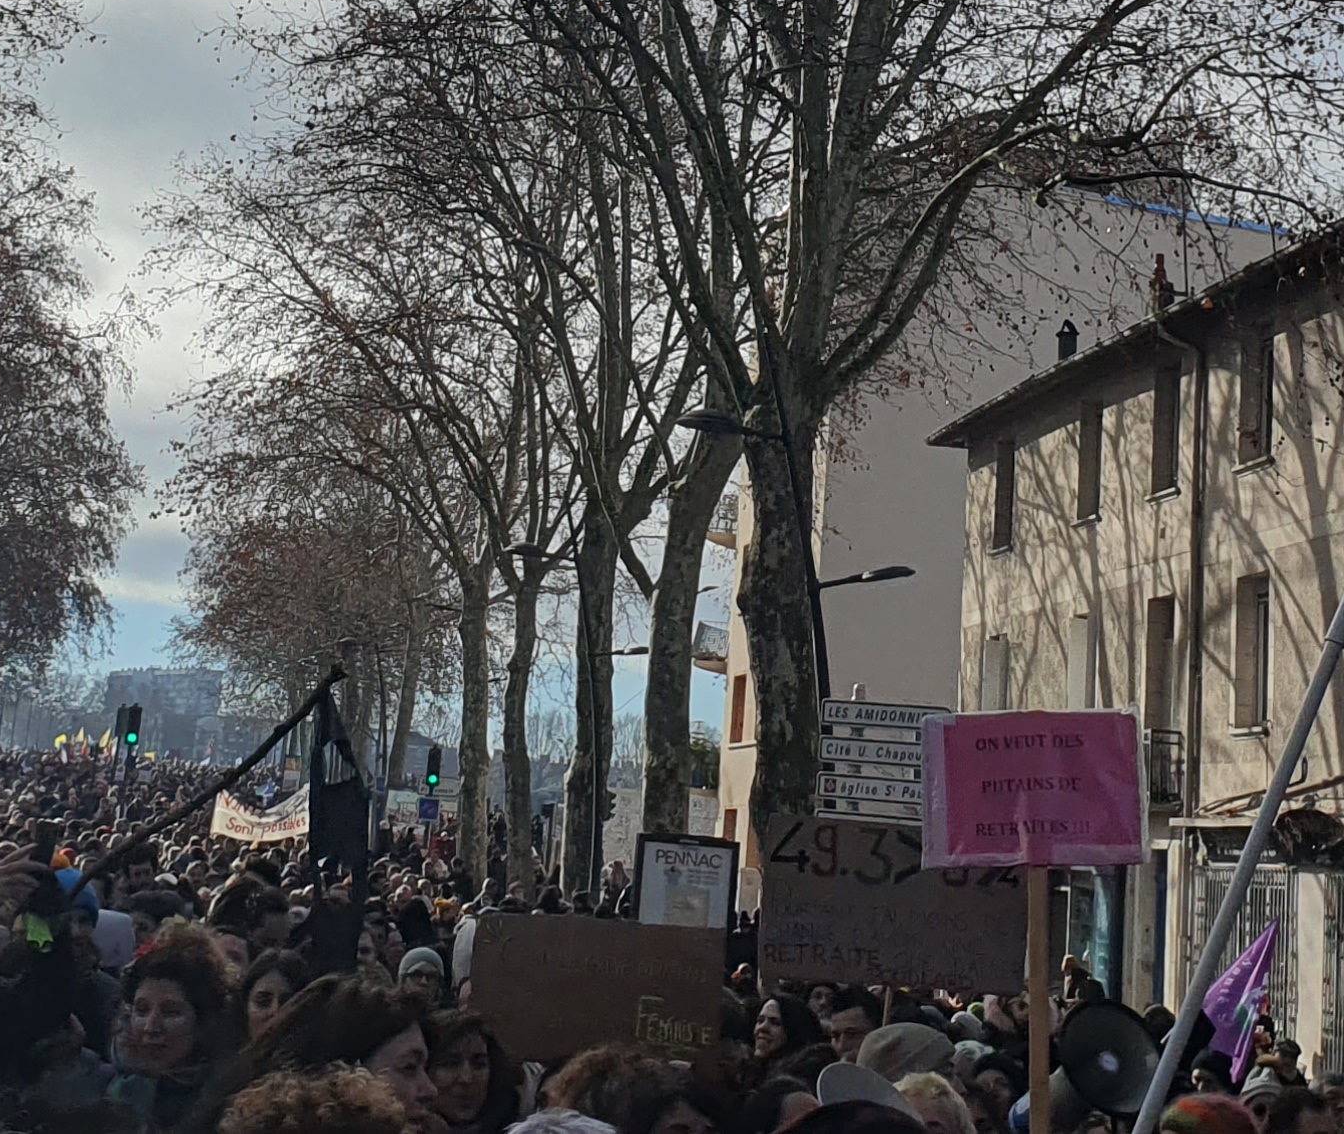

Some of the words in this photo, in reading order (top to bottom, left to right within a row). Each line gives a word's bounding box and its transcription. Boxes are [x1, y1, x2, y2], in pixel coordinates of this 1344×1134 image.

[828, 707, 850, 719] LES
[855, 708, 936, 724] AMIDONNI
[825, 742, 851, 757] Cité
[974, 737, 999, 751] ON
[1003, 735, 1045, 749] VEUT
[1049, 734, 1085, 748] DES
[981, 776, 1054, 793] PUTAINS
[1058, 776, 1082, 791] DE
[226, 817, 255, 835] Sont
[975, 820, 1069, 837] RETRAITES
[655, 849, 723, 869] PENNAC
[763, 943, 882, 968] RETRAITE
